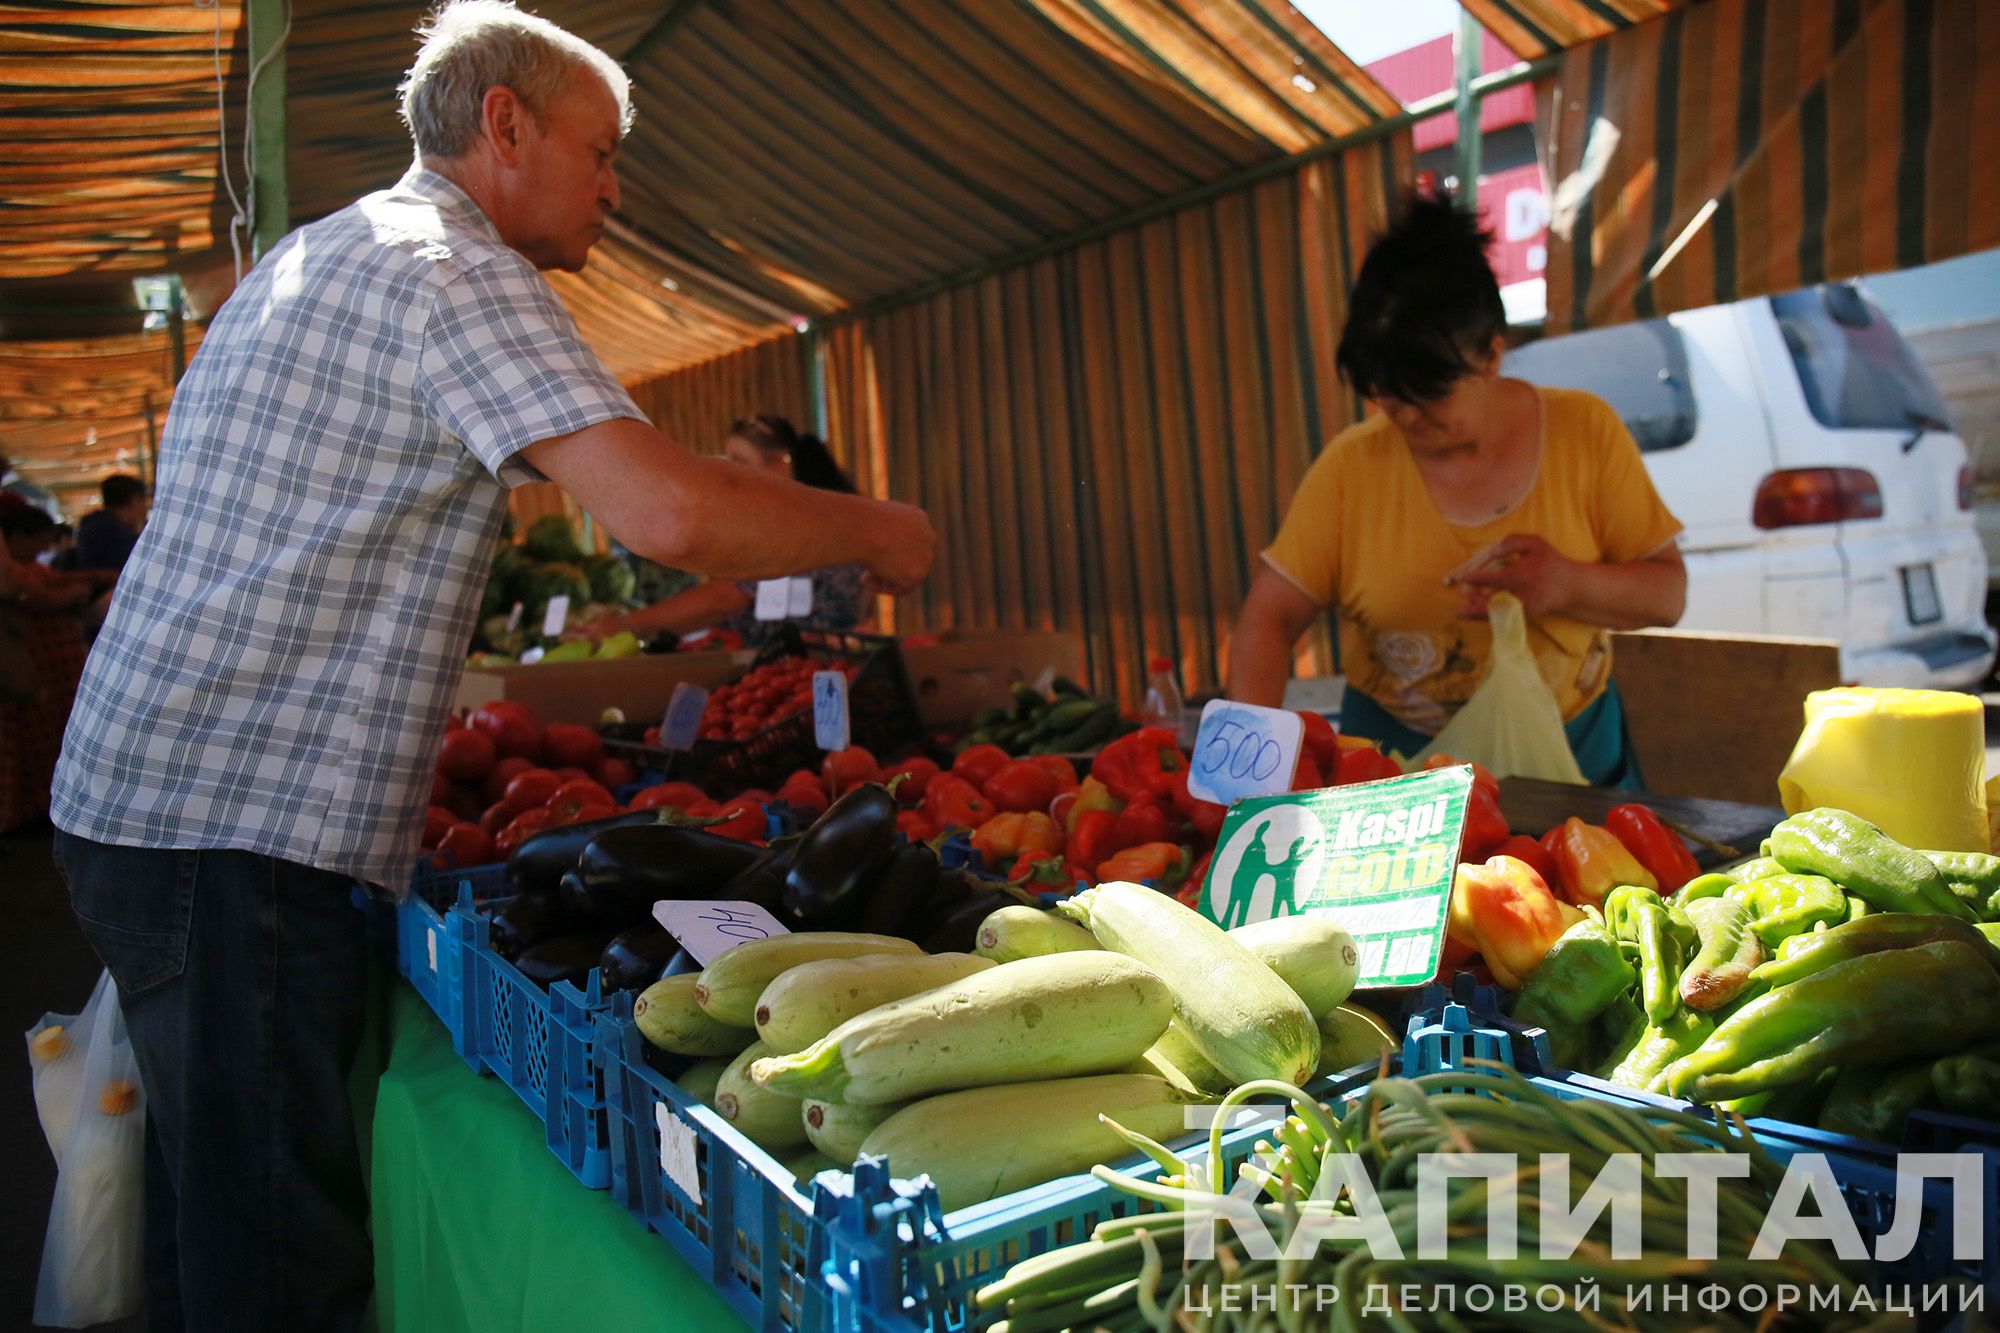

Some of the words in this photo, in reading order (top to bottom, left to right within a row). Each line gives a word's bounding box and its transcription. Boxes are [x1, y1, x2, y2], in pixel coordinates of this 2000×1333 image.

[1200, 720, 1282, 782] 500
[1333, 793, 1448, 851] Kaspi
[1324, 842, 1448, 898] GOLD
[697, 907, 769, 946] 40
